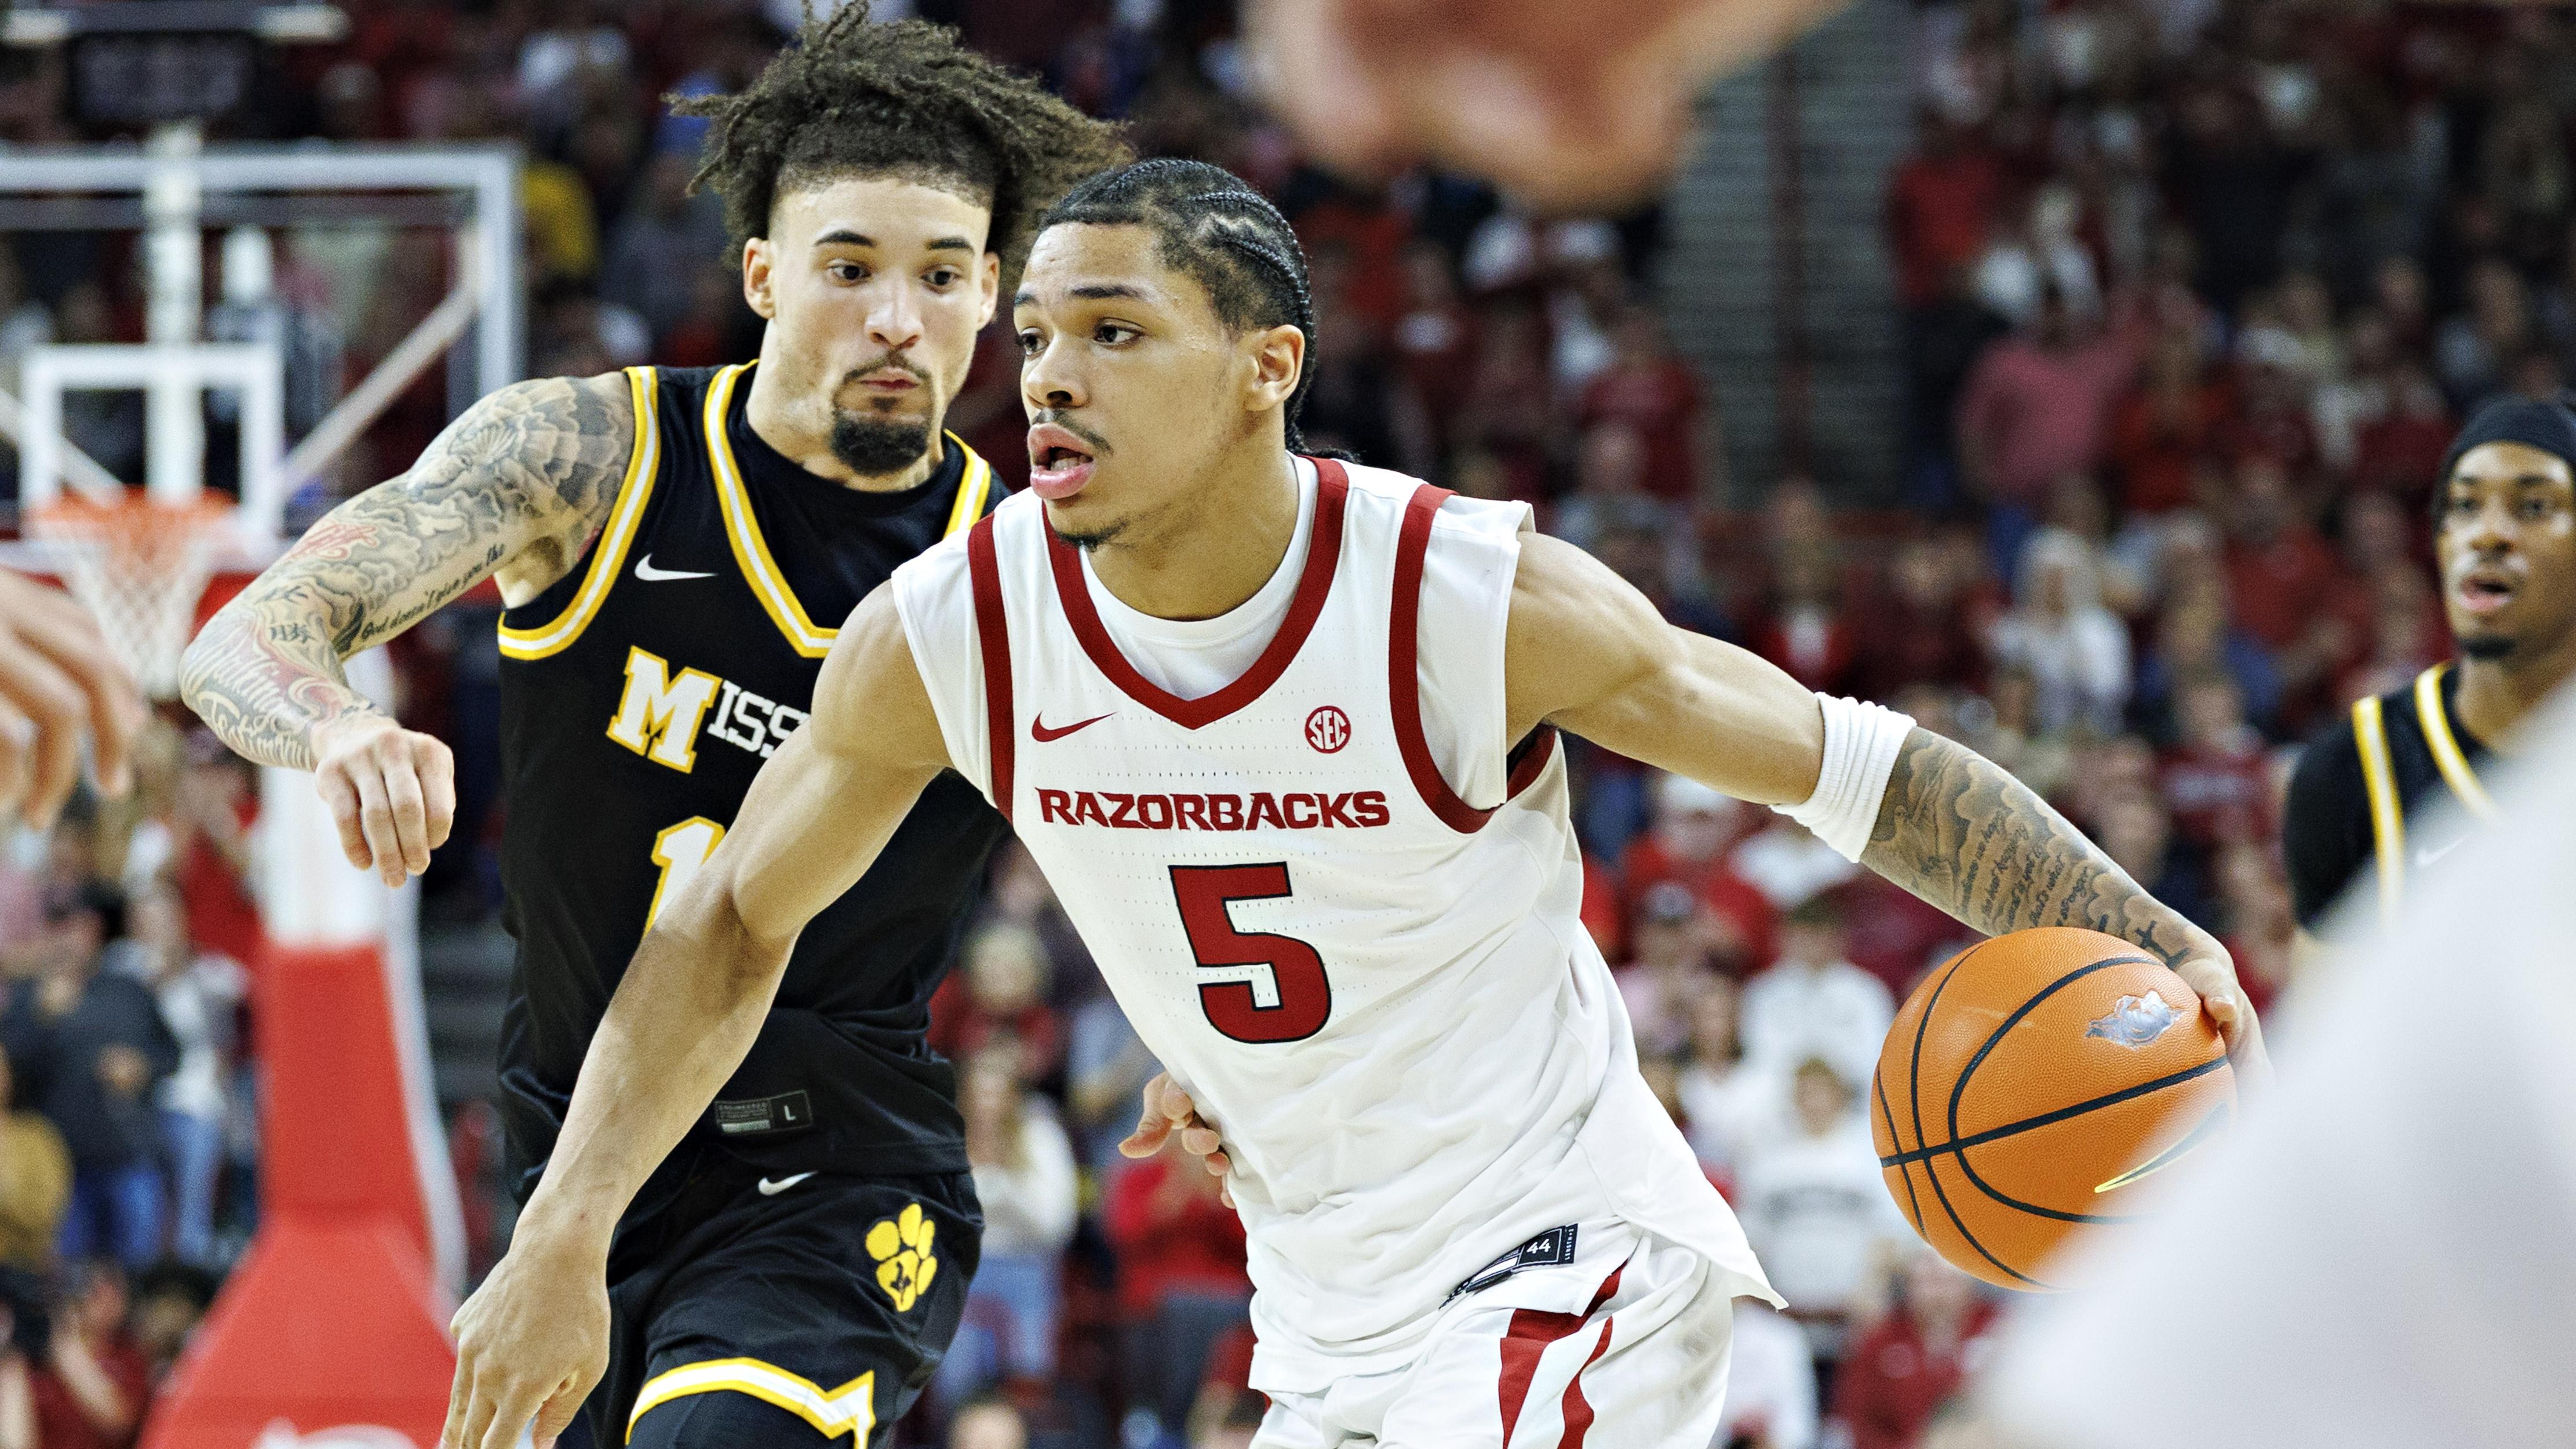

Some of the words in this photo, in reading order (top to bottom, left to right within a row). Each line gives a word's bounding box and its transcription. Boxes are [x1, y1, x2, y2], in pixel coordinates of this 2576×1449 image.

[1307, 709, 1348, 750] SEC
[1034, 787, 1390, 831] RAZORBACKS
[1168, 861, 1332, 1044] 5
[784, 1105, 797, 1120] L
[1526, 1239, 1551, 1254] 44
